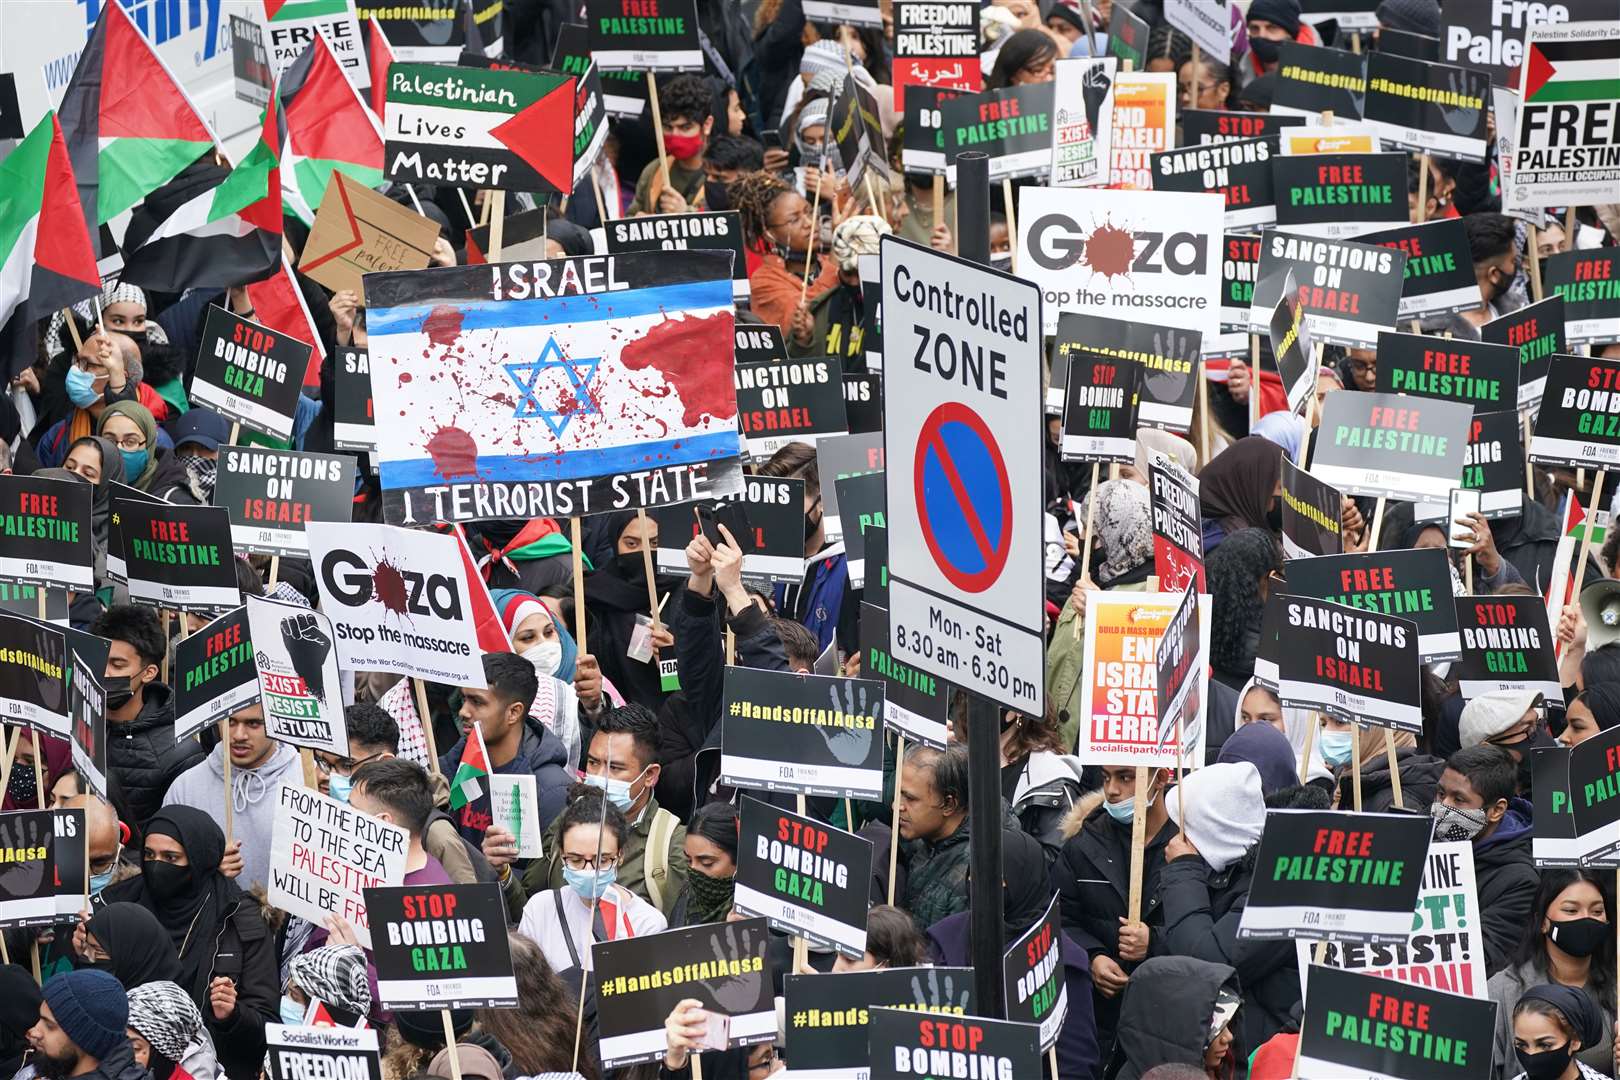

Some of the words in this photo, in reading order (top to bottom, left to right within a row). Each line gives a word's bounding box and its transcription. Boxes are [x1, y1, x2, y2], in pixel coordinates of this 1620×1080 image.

[622, 0, 659, 17] FREE
[901, 5, 972, 26] FREEDOM
[1492, 0, 1568, 28] Free
[600, 17, 685, 35] PALESTINE
[1532, 31, 1568, 39] Palestine
[1571, 29, 1608, 39] Solidarity
[897, 35, 977, 55] PALESTINE
[392, 73, 517, 107] Palestinian
[1370, 77, 1483, 110] #HandsOffAlAqsa
[979, 98, 1020, 121] FREE
[397, 114, 466, 140] Lives
[957, 113, 1049, 146] PALESTINE
[1113, 128, 1163, 148] RAELI
[1218, 118, 1265, 135] STOP
[391, 151, 507, 186] Matter
[1160, 143, 1269, 175] SANCTIONS
[1203, 168, 1228, 188] ON
[1318, 166, 1364, 185] FREE
[1516, 173, 1536, 184] END
[1537, 172, 1574, 183] ISRAELI
[1291, 184, 1392, 206] PALESTINE
[616, 216, 729, 242] SANCTIONS
[1027, 213, 1208, 276] Gza
[1271, 236, 1392, 275] SANCTIONS
[492, 256, 629, 300] ISRAEL
[1314, 267, 1342, 289] ON
[1575, 260, 1611, 279] FREE
[894, 265, 1028, 343] Controlled
[1042, 289, 1070, 308] top
[1076, 288, 1106, 306] the
[1111, 292, 1208, 310] massacre
[1298, 287, 1360, 314] SRAEL
[233, 323, 274, 354] STOP
[1508, 319, 1538, 346] FREE
[215, 338, 286, 384] BOMBING
[1521, 332, 1557, 364] STINE
[913, 325, 1008, 400] ZONE
[1092, 364, 1116, 384] STOP
[1424, 350, 1471, 375] FREE
[224, 366, 264, 398] GAZA
[1392, 368, 1500, 401] PALESTINE
[762, 388, 789, 408] ON
[1079, 386, 1124, 408] BOMBING
[743, 408, 812, 432] ISRAEL
[1088, 410, 1110, 430] GAZA
[1369, 407, 1420, 430] FREE
[1335, 425, 1448, 457] PALESTINE
[227, 452, 341, 481] SANCTIONS
[266, 478, 292, 499] ON
[424, 480, 593, 523] TERRORIST
[612, 463, 708, 508] STATE
[1154, 472, 1196, 521] FREEDOM
[20, 493, 58, 516] FREE
[245, 499, 312, 522] ISRAEL
[151, 520, 189, 541] FREE
[1154, 506, 1201, 559] PALESTINE
[133, 543, 219, 566] PALESTINE
[321, 549, 464, 622] Gza
[1340, 567, 1395, 591] FREE
[1288, 603, 1407, 649] SANCTIONS
[1475, 603, 1516, 625] STOP
[207, 624, 241, 657] FREE
[336, 622, 375, 645] Stop
[378, 625, 402, 643] the
[403, 632, 471, 657] massacre
[930, 606, 962, 640] Mon
[975, 625, 1002, 656] Sat
[1158, 589, 1195, 672] SANCTIONS
[1463, 627, 1540, 649] BOMBING
[897, 624, 933, 658] 8.30
[937, 648, 959, 670] am
[972, 656, 1009, 690] 6.30
[1013, 672, 1037, 701] pm
[1122, 636, 1157, 662] EN
[1336, 637, 1360, 664] ON
[1486, 651, 1528, 673] GAZA
[0, 648, 62, 679] dsOffAlAqsa
[186, 642, 253, 691] PALESTIN
[350, 658, 366, 666] Stop
[366, 658, 377, 666] the
[379, 660, 391, 668] War
[415, 667, 469, 681] www.stopwar.org.uk
[870, 648, 937, 697] PALESTINE
[1097, 661, 1157, 689] ISRA
[1315, 656, 1383, 692] ISRAEL
[263, 674, 307, 695] EXIST.
[268, 696, 320, 717] RESIST.
[1107, 688, 1158, 716] STA
[273, 717, 332, 740] RETURN.
[729, 702, 875, 731] #HandsOffAlAqsa
[1092, 715, 1159, 742] TERR
[779, 767, 794, 779] FOA
[281, 785, 322, 819] FROM
[324, 801, 354, 834] THE
[355, 818, 404, 853] RIVER
[291, 816, 312, 843] TO
[318, 828, 349, 859] THE
[351, 844, 387, 879] SEA
[777, 816, 828, 854] STOP
[1314, 829, 1374, 856] FREE
[756, 835, 848, 890] BOMBING
[1274, 855, 1404, 887] PALESTINE
[273, 870, 311, 903] WILL
[319, 889, 340, 913] BE
[774, 869, 824, 907] GAZA
[403, 893, 457, 919] STOP
[782, 906, 796, 922] FOA
[1302, 911, 1320, 925] FOA
[386, 919, 485, 946] BOMBING
[1026, 923, 1052, 967] STOP
[411, 947, 467, 972] GAZA
[1017, 937, 1060, 1004] BOMBING
[601, 955, 764, 997] #HandsOffAlAqsa
[426, 984, 440, 997] FOA
[1032, 976, 1057, 1019] GAZA
[1368, 992, 1431, 1031] FREE
[282, 1030, 321, 1043] Socialist
[322, 1034, 360, 1047] Worker
[920, 1021, 984, 1052] STOP
[1326, 1011, 1468, 1067] PALESTINE
[279, 1050, 371, 1080] FREEDOM
[894, 1046, 1013, 1080] BOMBING
